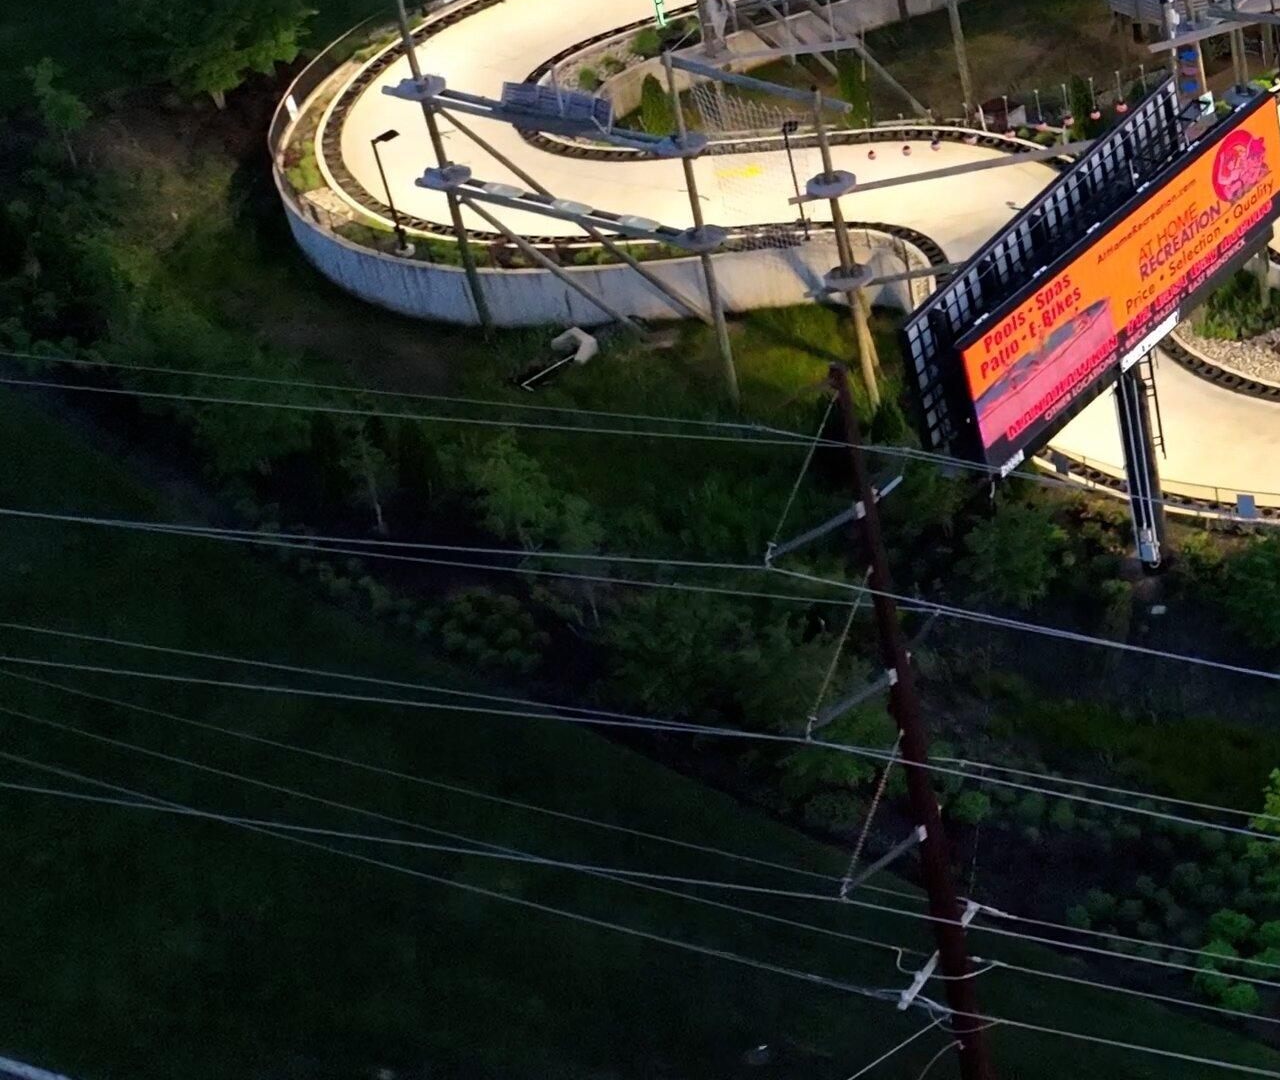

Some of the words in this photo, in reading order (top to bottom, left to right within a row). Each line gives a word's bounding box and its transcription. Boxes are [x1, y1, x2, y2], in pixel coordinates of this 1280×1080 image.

[1127, 283, 1156, 314] Price
[1168, 227, 1221, 276] Selection
[1233, 178, 1274, 219] Quality
[1139, 238, 1153, 262] AT
[1157, 202, 1198, 247] HOME
[1140, 200, 1222, 282] RECREATION
[980, 339, 1019, 379] Patio
[1028, 287, 1082, 338] E-Bikes
[983, 312, 1026, 354] Pools
[1035, 274, 1071, 311] Spas
